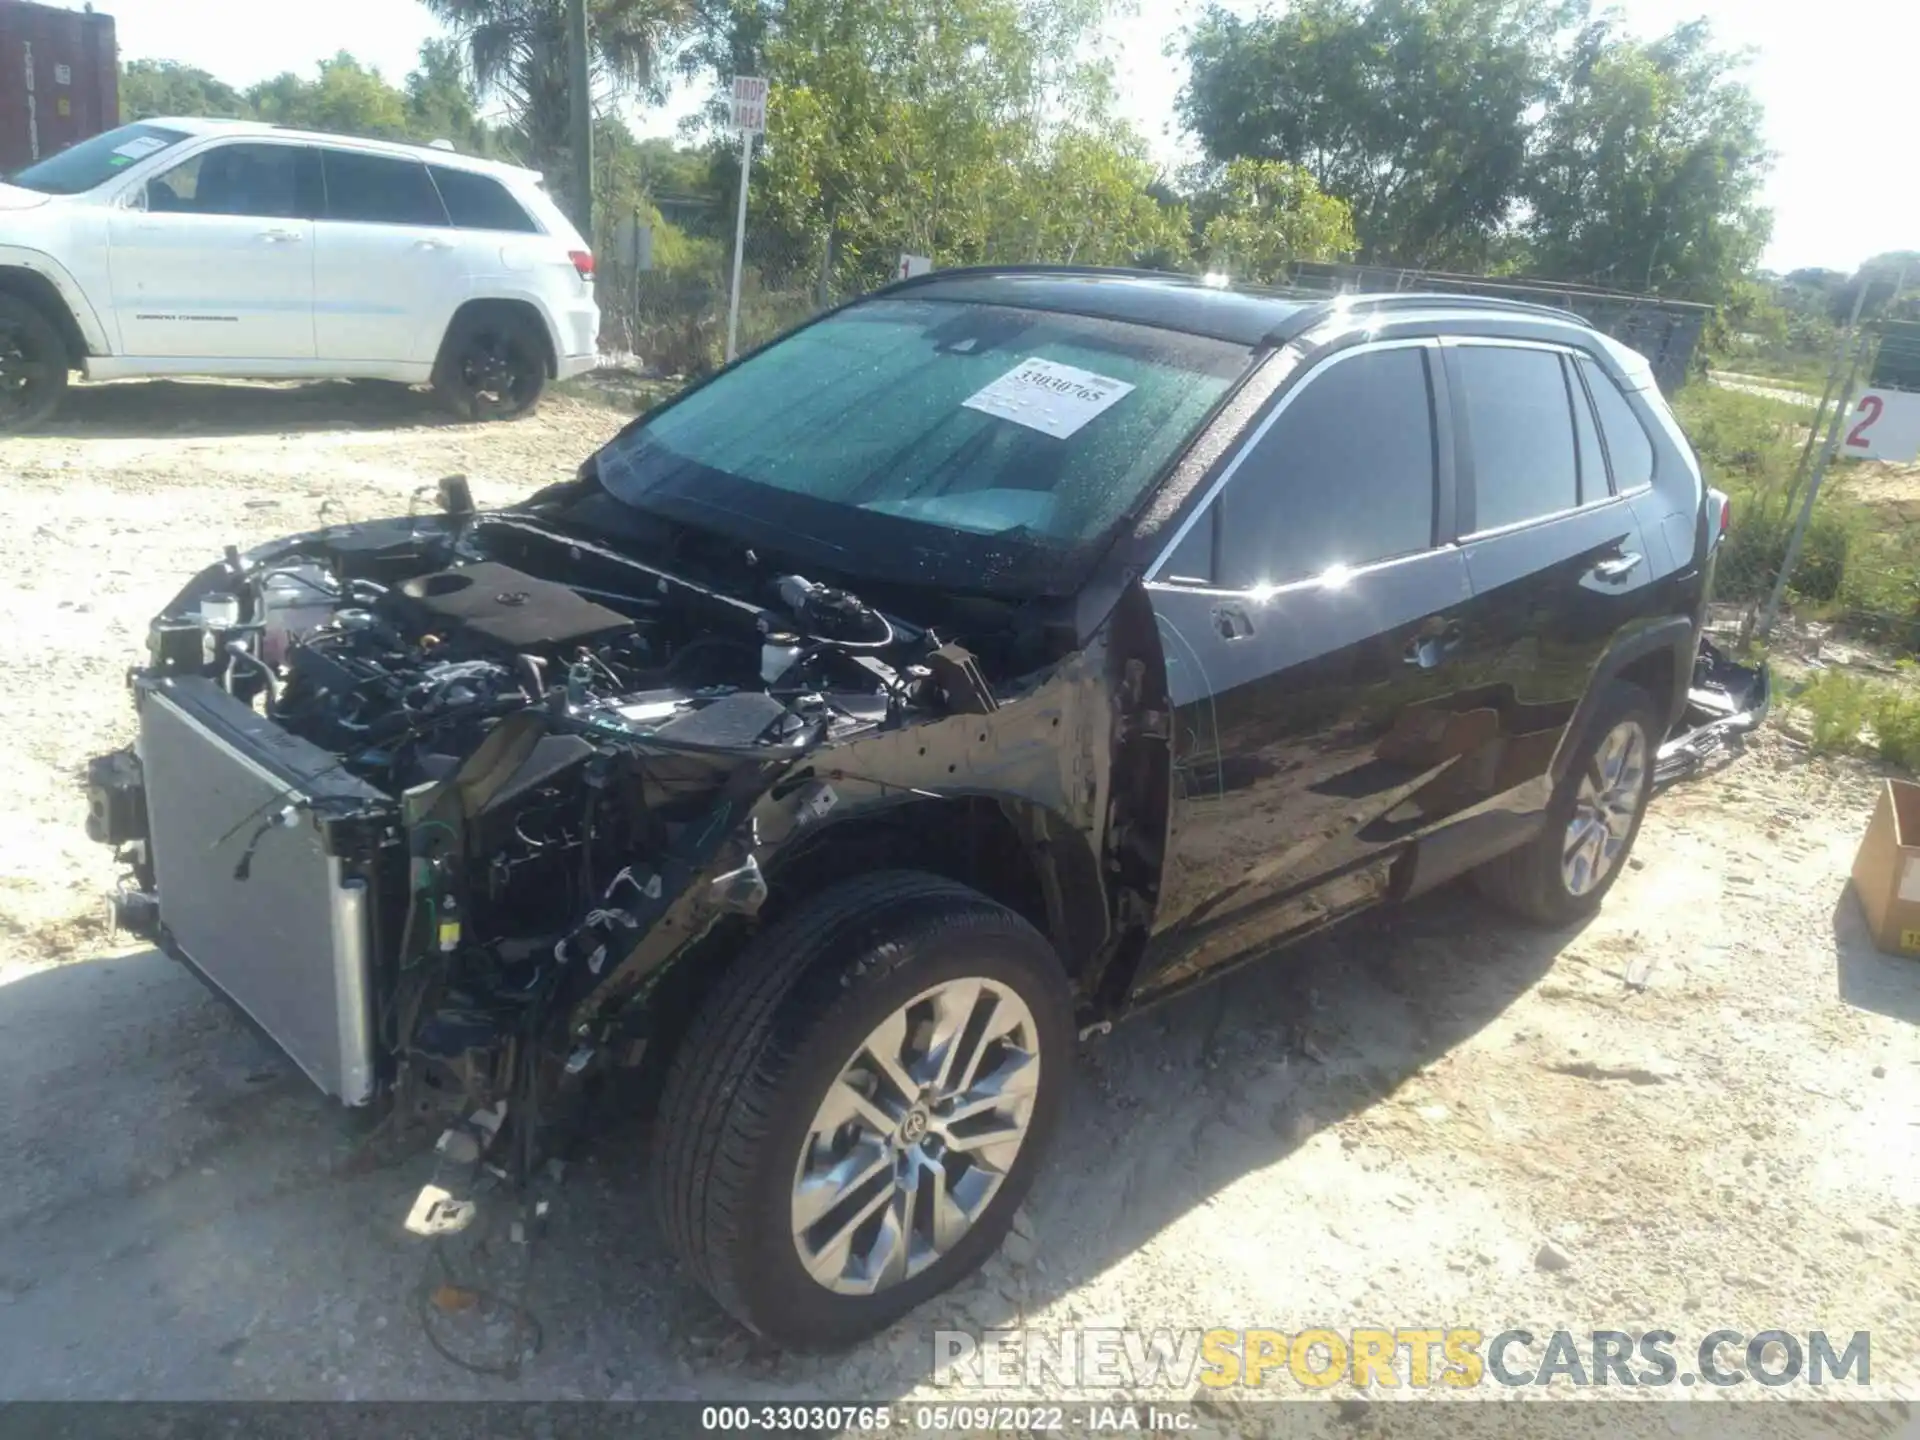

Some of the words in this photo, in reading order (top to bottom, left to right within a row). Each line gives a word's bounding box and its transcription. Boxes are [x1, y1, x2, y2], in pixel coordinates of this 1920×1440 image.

[735, 79, 766, 103] DROP
[733, 104, 763, 130] AREA
[1014, 370, 1106, 401] 33030765
[1845, 395, 1884, 449] 2
